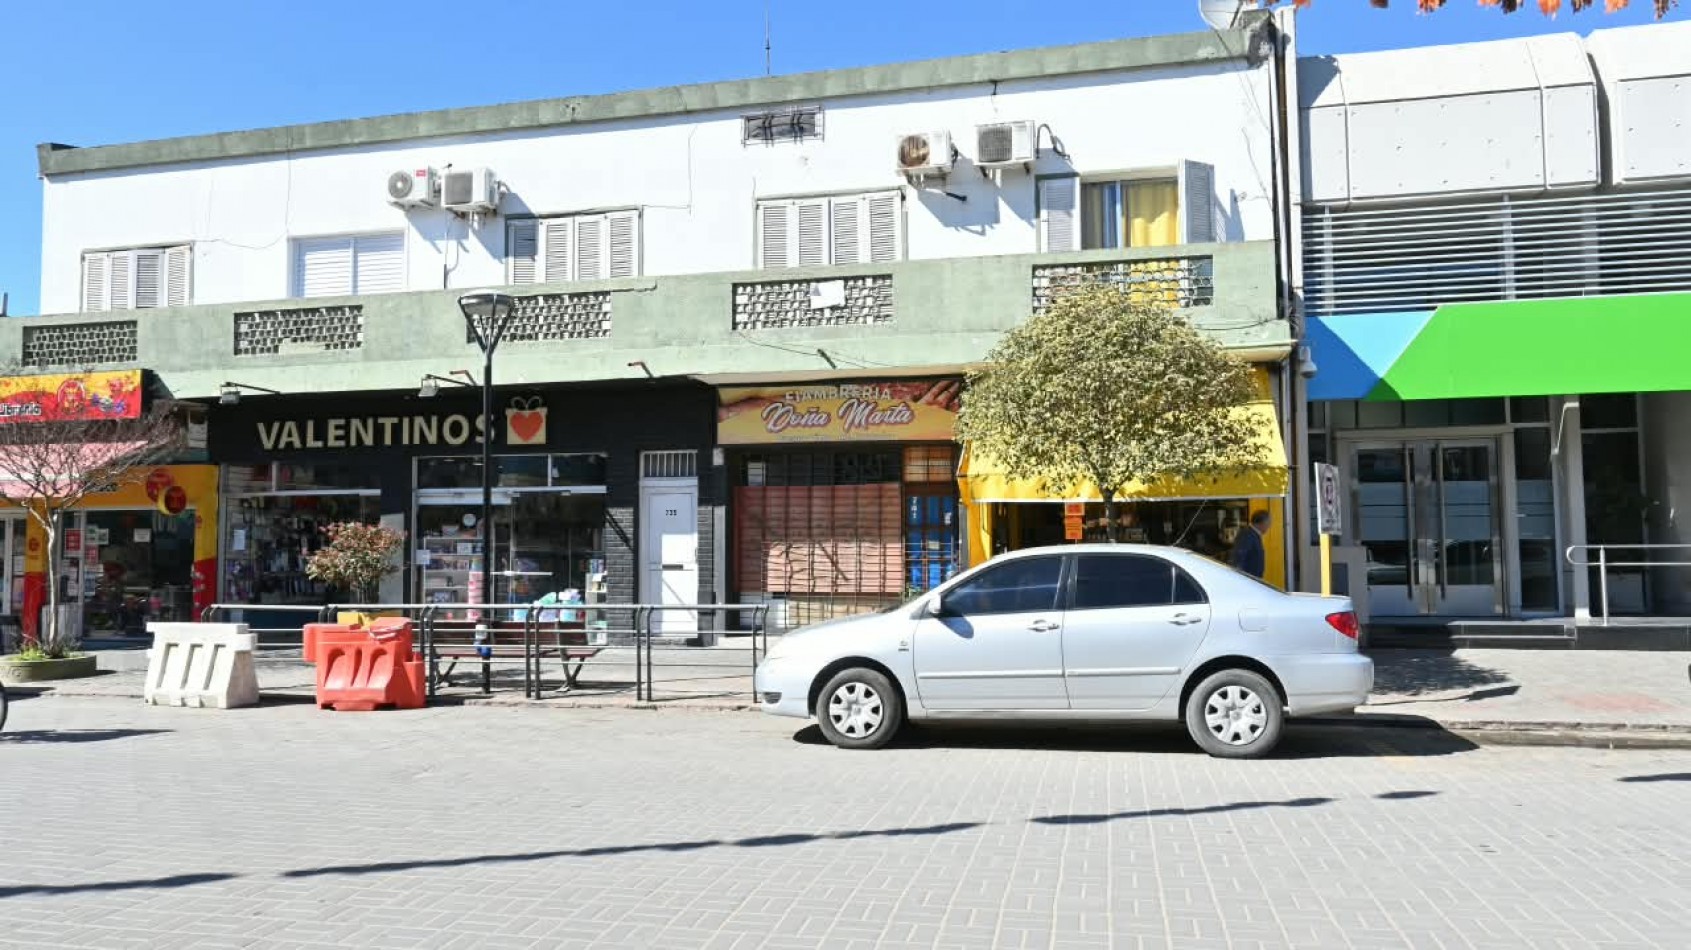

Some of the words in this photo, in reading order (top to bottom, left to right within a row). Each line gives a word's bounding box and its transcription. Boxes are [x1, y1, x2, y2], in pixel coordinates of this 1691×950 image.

[256, 413, 495, 450] VALENTINOS
[761, 402, 831, 432] Doña
[837, 398, 913, 432] Marta
